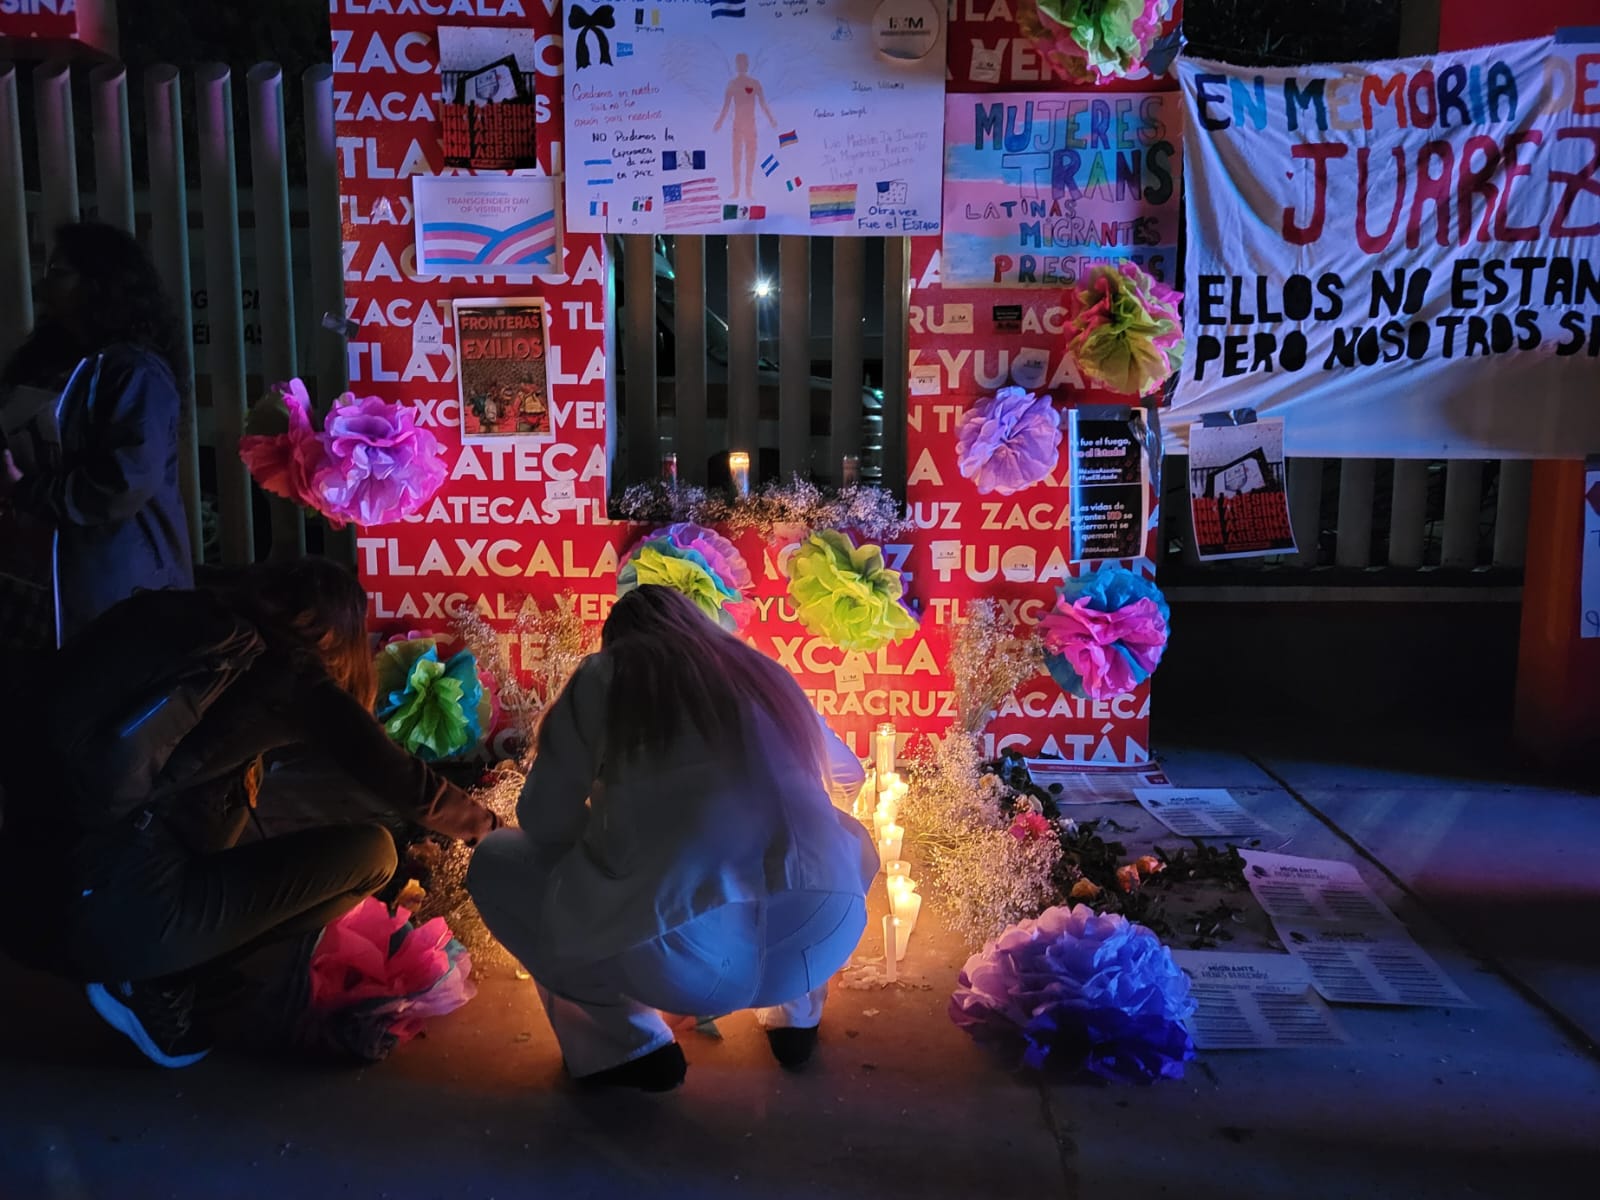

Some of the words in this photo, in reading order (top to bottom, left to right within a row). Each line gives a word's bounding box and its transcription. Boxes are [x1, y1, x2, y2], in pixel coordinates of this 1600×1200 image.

[1195, 73, 1268, 131] EN
[1283, 60, 1518, 131] MEMORIA
[1541, 53, 1600, 116] DE
[975, 96, 1166, 152] MUJERES
[1002, 140, 1175, 205] TRANS
[1282, 127, 1600, 255] JUAREZ
[447, 197, 510, 206] TRANSGENDER
[512, 197, 530, 206] DAY
[966, 199, 1077, 220] LATINAS
[1019, 217, 1161, 248] MIGRANTES
[1198, 272, 1346, 326] ELLOS
[1368, 267, 1432, 319] NO
[1451, 257, 1600, 309] ESTAN
[460, 315, 541, 330] FRONTERAS
[1194, 330, 1308, 381] PERO
[1323, 310, 1542, 371] NOSOTROS
[463, 337, 543, 360] EXILIOS
[357, 537, 617, 578] TLAXCALA
